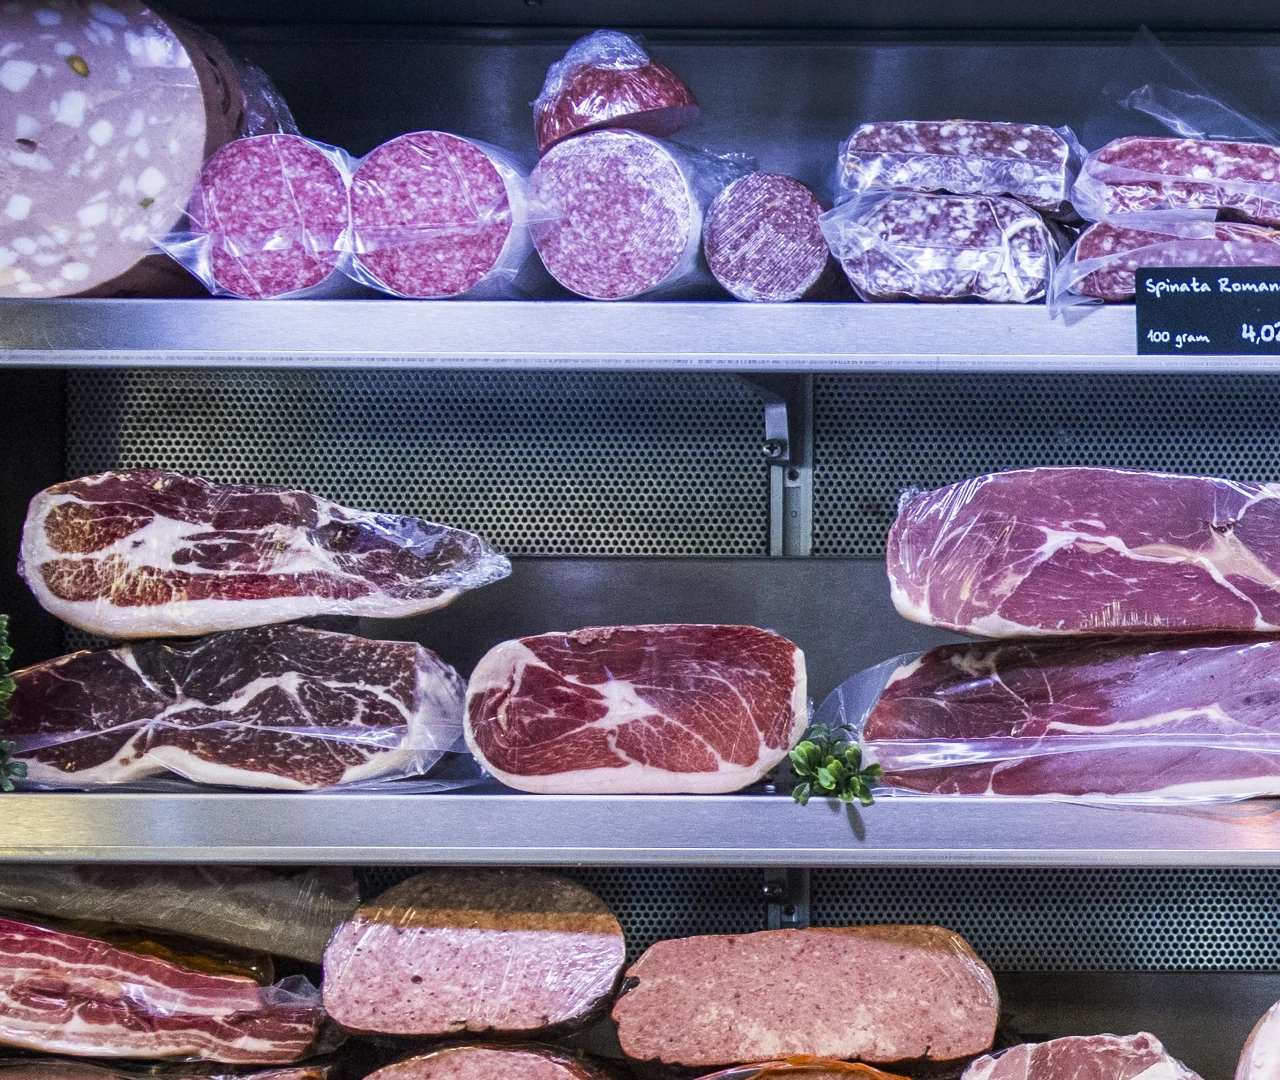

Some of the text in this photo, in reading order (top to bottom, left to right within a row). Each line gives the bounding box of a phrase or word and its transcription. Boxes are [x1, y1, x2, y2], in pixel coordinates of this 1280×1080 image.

[1145, 277, 1211, 298] Spinata
[1147, 329, 1170, 343] 100
[1175, 333, 1211, 348] gram
